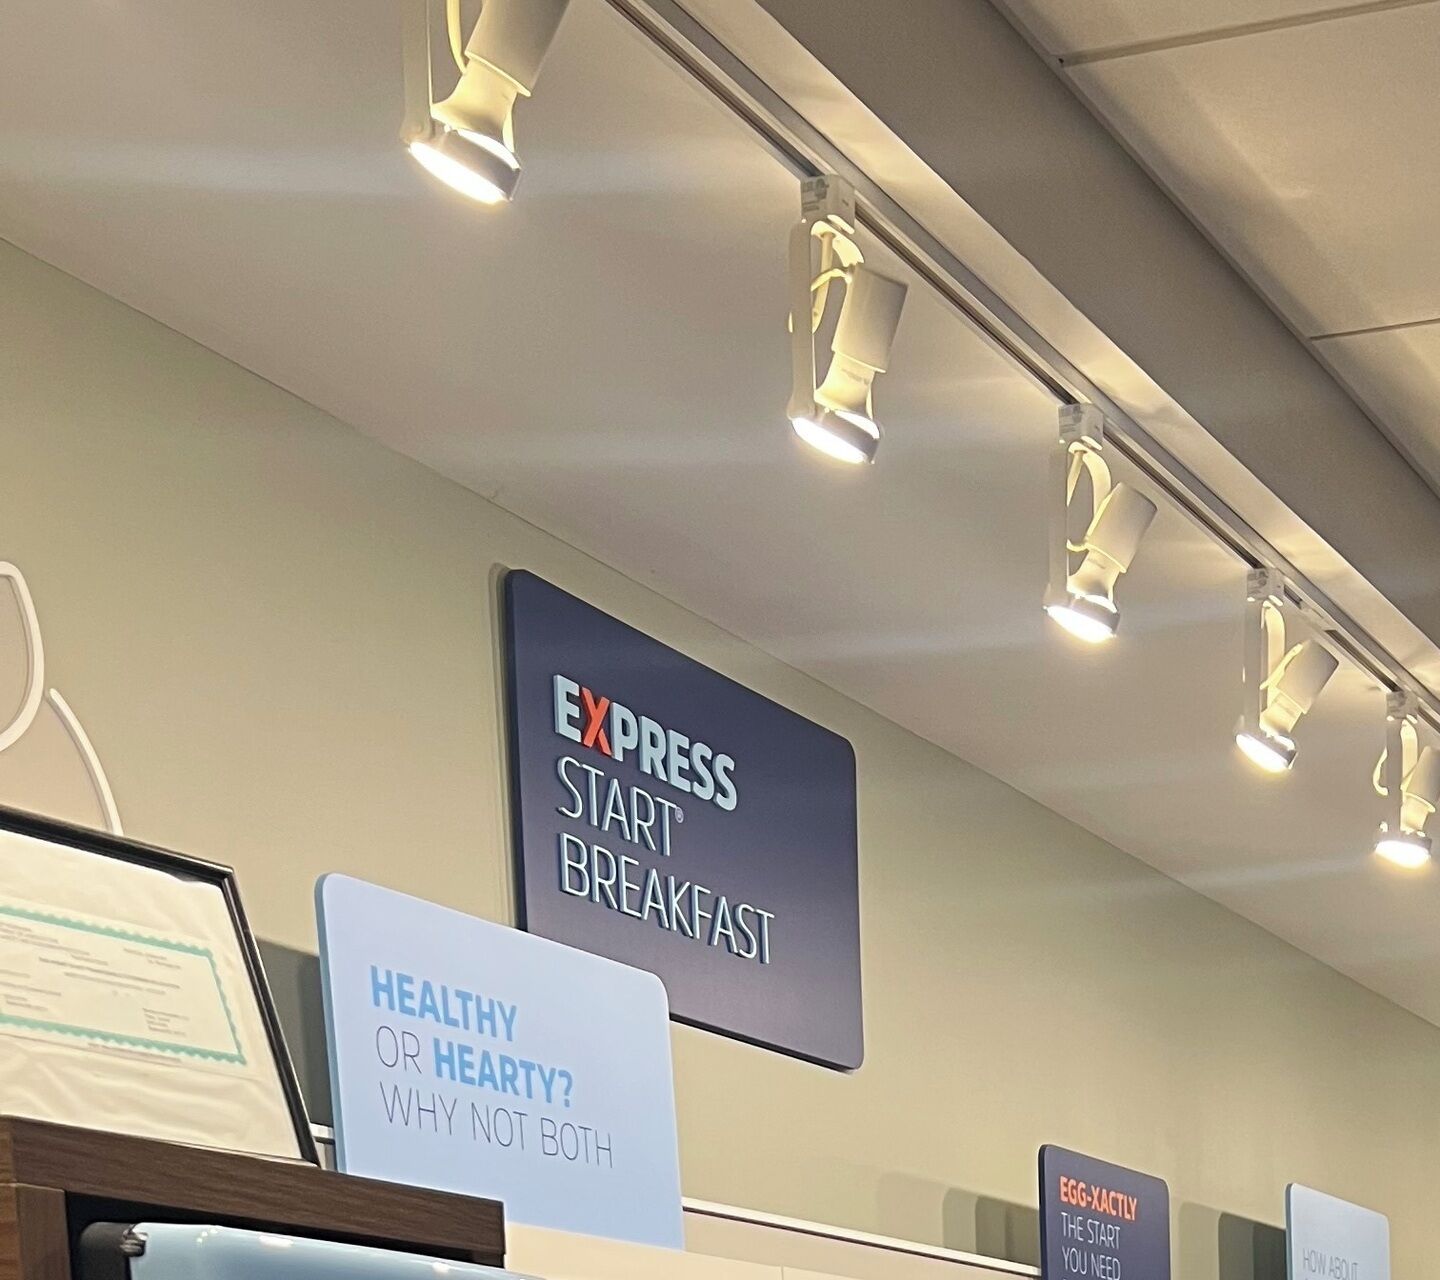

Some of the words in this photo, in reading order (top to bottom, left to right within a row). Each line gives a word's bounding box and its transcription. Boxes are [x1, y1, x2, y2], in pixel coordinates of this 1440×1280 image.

[554, 674, 738, 811] EXPRESS
[557, 756, 678, 856] START
[559, 832, 775, 964] BREAKFAST
[370, 965, 517, 1042] HEALTHY
[376, 1025, 422, 1074] OR
[433, 1037, 574, 1108] HEARTY?
[380, 1081, 457, 1136] WHY
[471, 1102, 528, 1150] NOT
[540, 1117, 613, 1168] BOTH
[1060, 1175, 1137, 1220] EGG-XACTLY
[1061, 1212, 1084, 1241] THE
[1087, 1218, 1120, 1249] START
[1062, 1246, 1087, 1275] YOU
[1091, 1253, 1120, 1280] NEED
[1303, 1248, 1326, 1275] HOW
